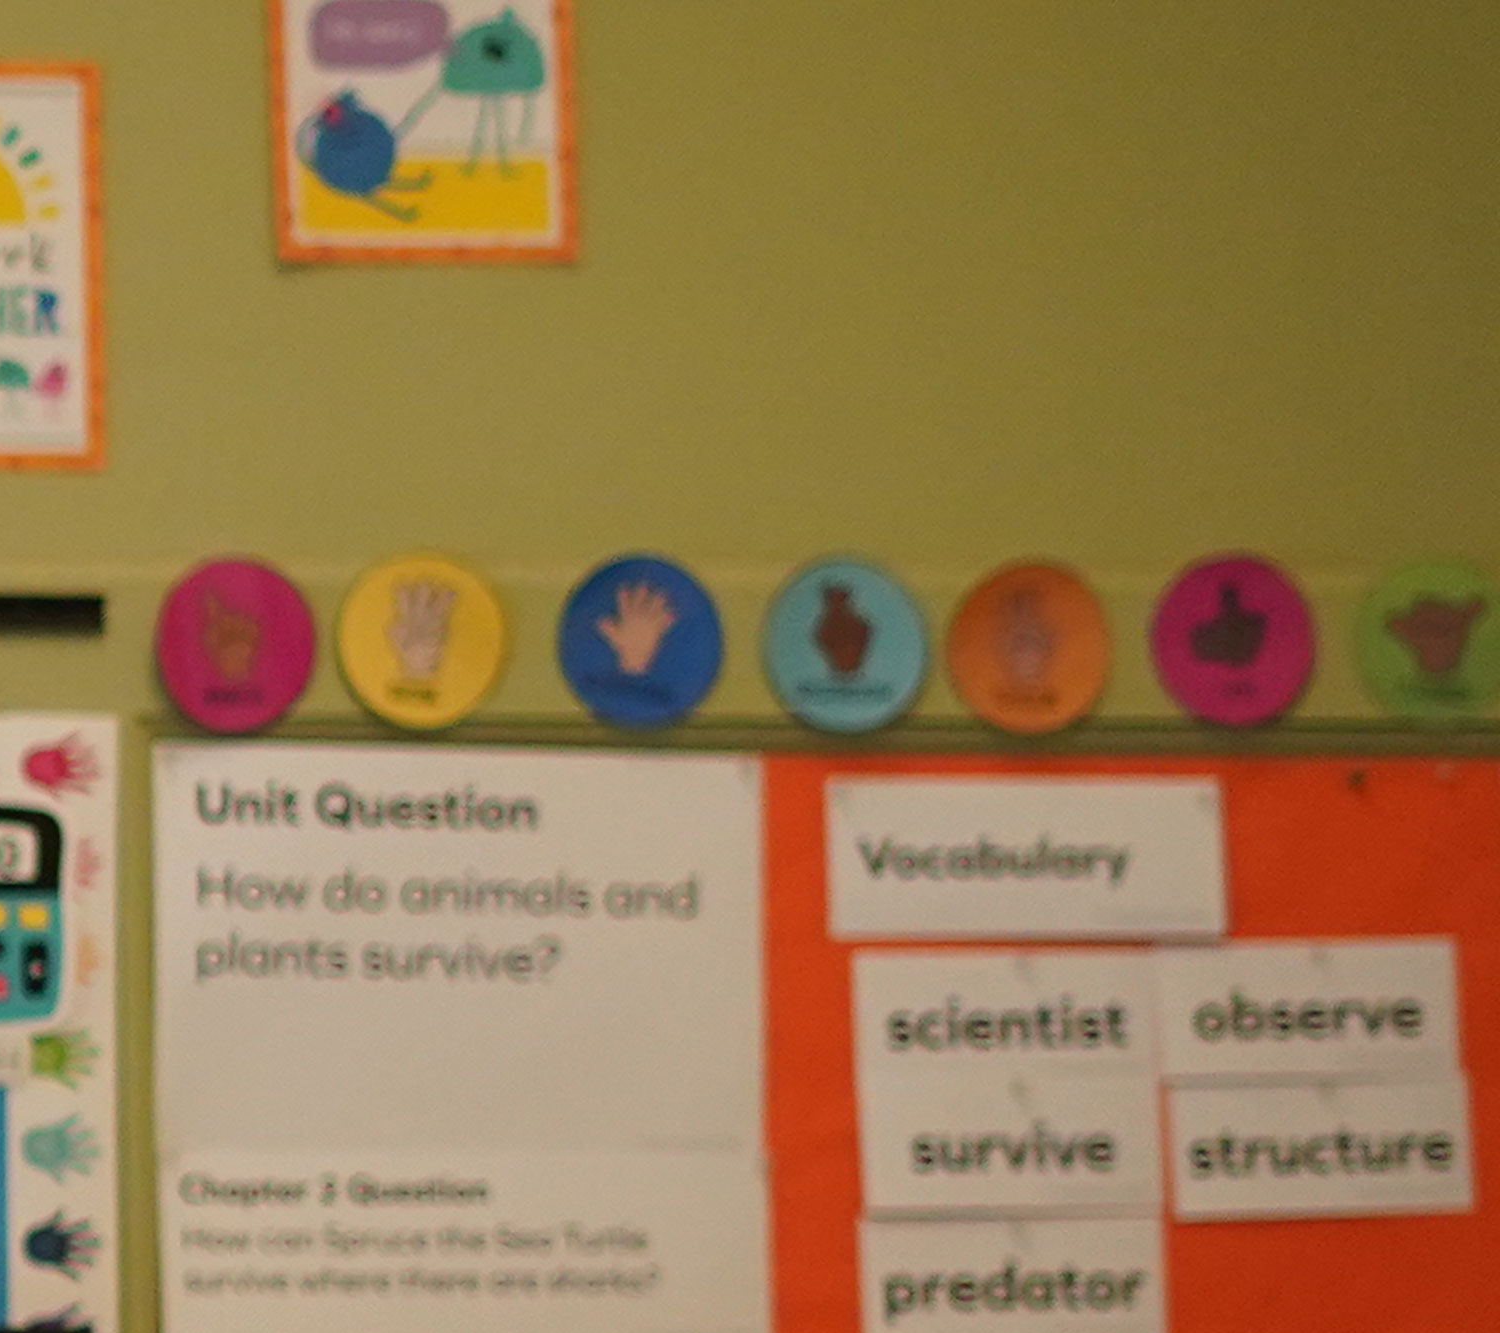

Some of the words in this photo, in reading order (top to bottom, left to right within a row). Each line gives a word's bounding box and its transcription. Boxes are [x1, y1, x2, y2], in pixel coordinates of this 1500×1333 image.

[196, 780, 300, 826] Unit
[313, 780, 540, 832] Question
[856, 832, 1132, 890] Vocabulary
[198, 868, 305, 914] How
[322, 865, 389, 915] do
[400, 868, 594, 920] animals
[604, 872, 699, 920] and
[196, 930, 349, 984] plants
[360, 934, 562, 982] survive?
[884, 996, 1128, 1052] scientist
[1191, 986, 1424, 1042] observe
[910, 1118, 1118, 1174] survive
[1189, 1126, 1456, 1180] structure
[882, 1256, 1148, 1326] predator
